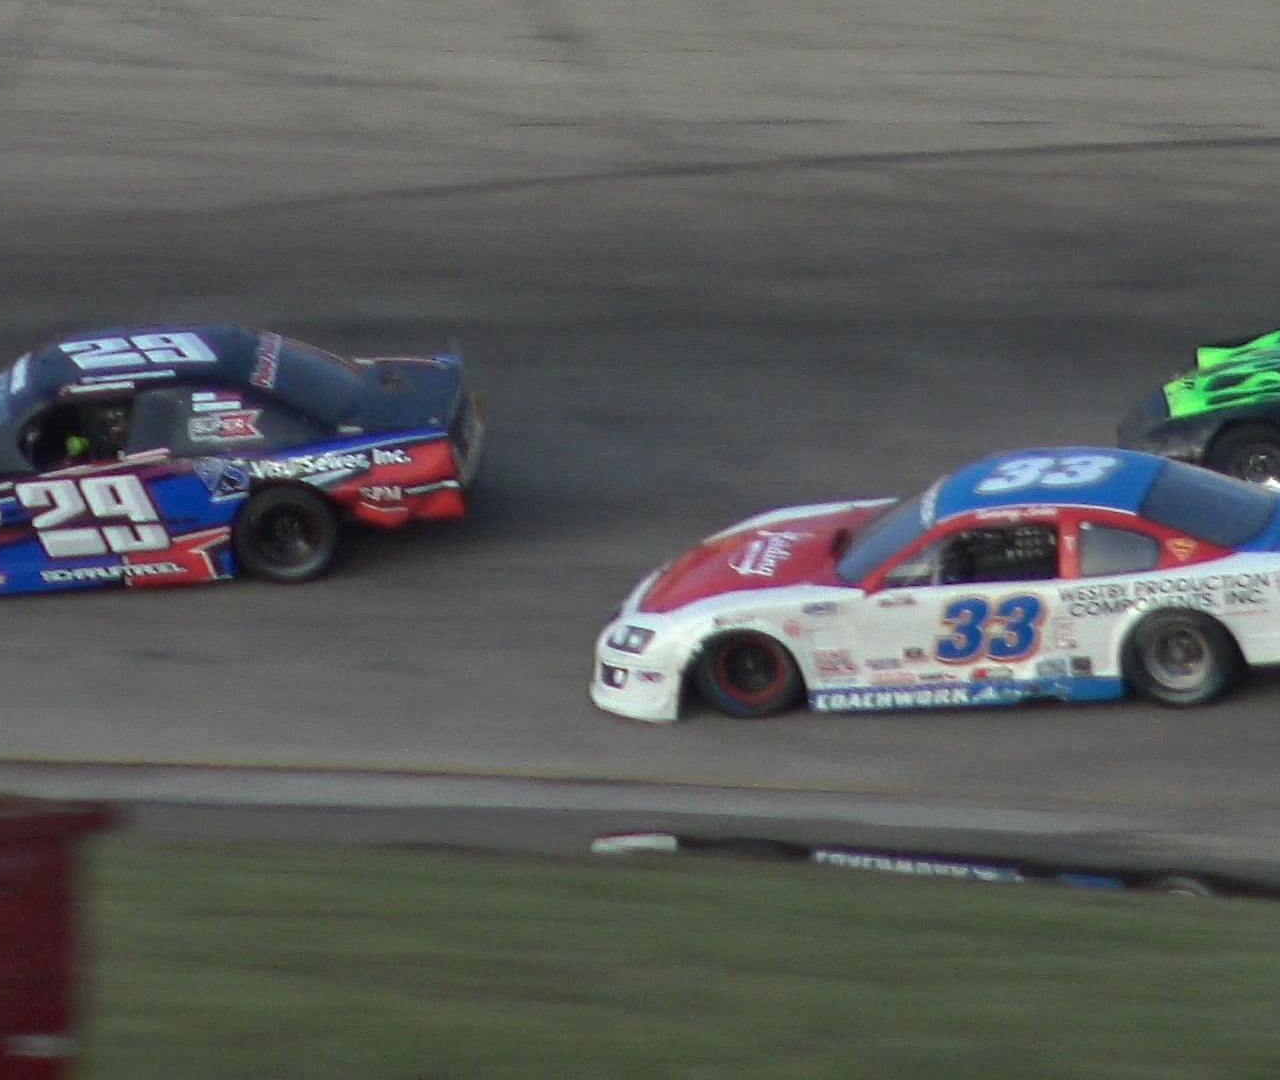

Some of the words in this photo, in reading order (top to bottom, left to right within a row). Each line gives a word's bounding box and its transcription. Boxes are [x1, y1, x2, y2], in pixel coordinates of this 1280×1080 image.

[58, 331, 218, 370] 29
[973, 454, 1118, 497] 33
[15, 474, 171, 558] 29
[935, 593, 1046, 665] 33
